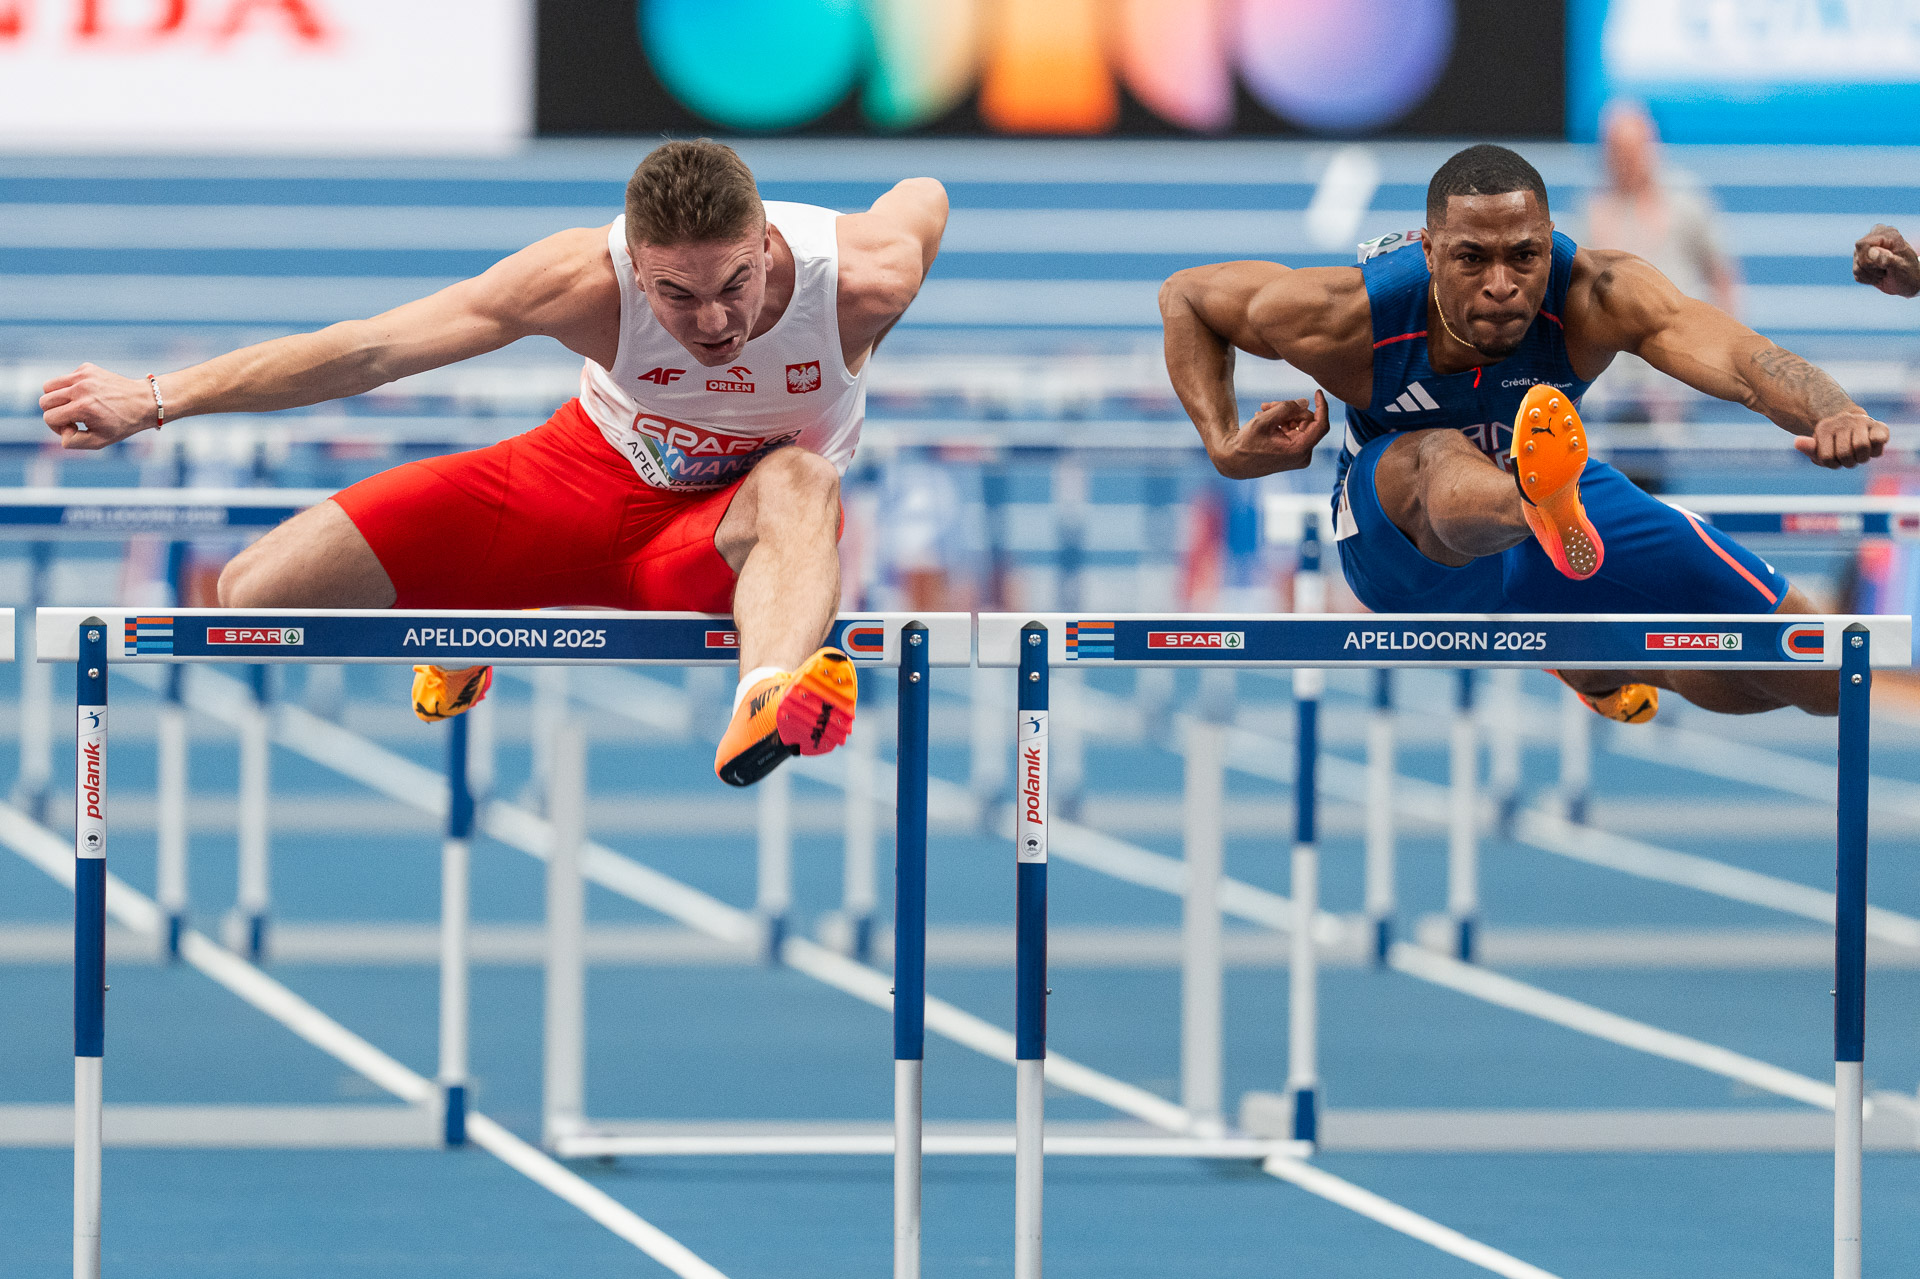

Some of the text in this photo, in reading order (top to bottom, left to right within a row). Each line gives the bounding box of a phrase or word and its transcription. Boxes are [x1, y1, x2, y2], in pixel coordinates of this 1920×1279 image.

[637, 367, 687, 386] 4F
[1501, 378, 1532, 388] Crédit
[709, 381, 752, 392] ORLEN
[636, 417, 761, 456] SPAR
[225, 630, 280, 642] SPAR
[402, 628, 607, 648] APELDOORN 2025
[1165, 634, 1221, 646] SPAR
[1343, 631, 1547, 651] APELDOORN 2025
[1663, 635, 1719, 647] SPAR
[83, 741, 103, 820] polanik
[1023, 746, 1043, 825] polanik
